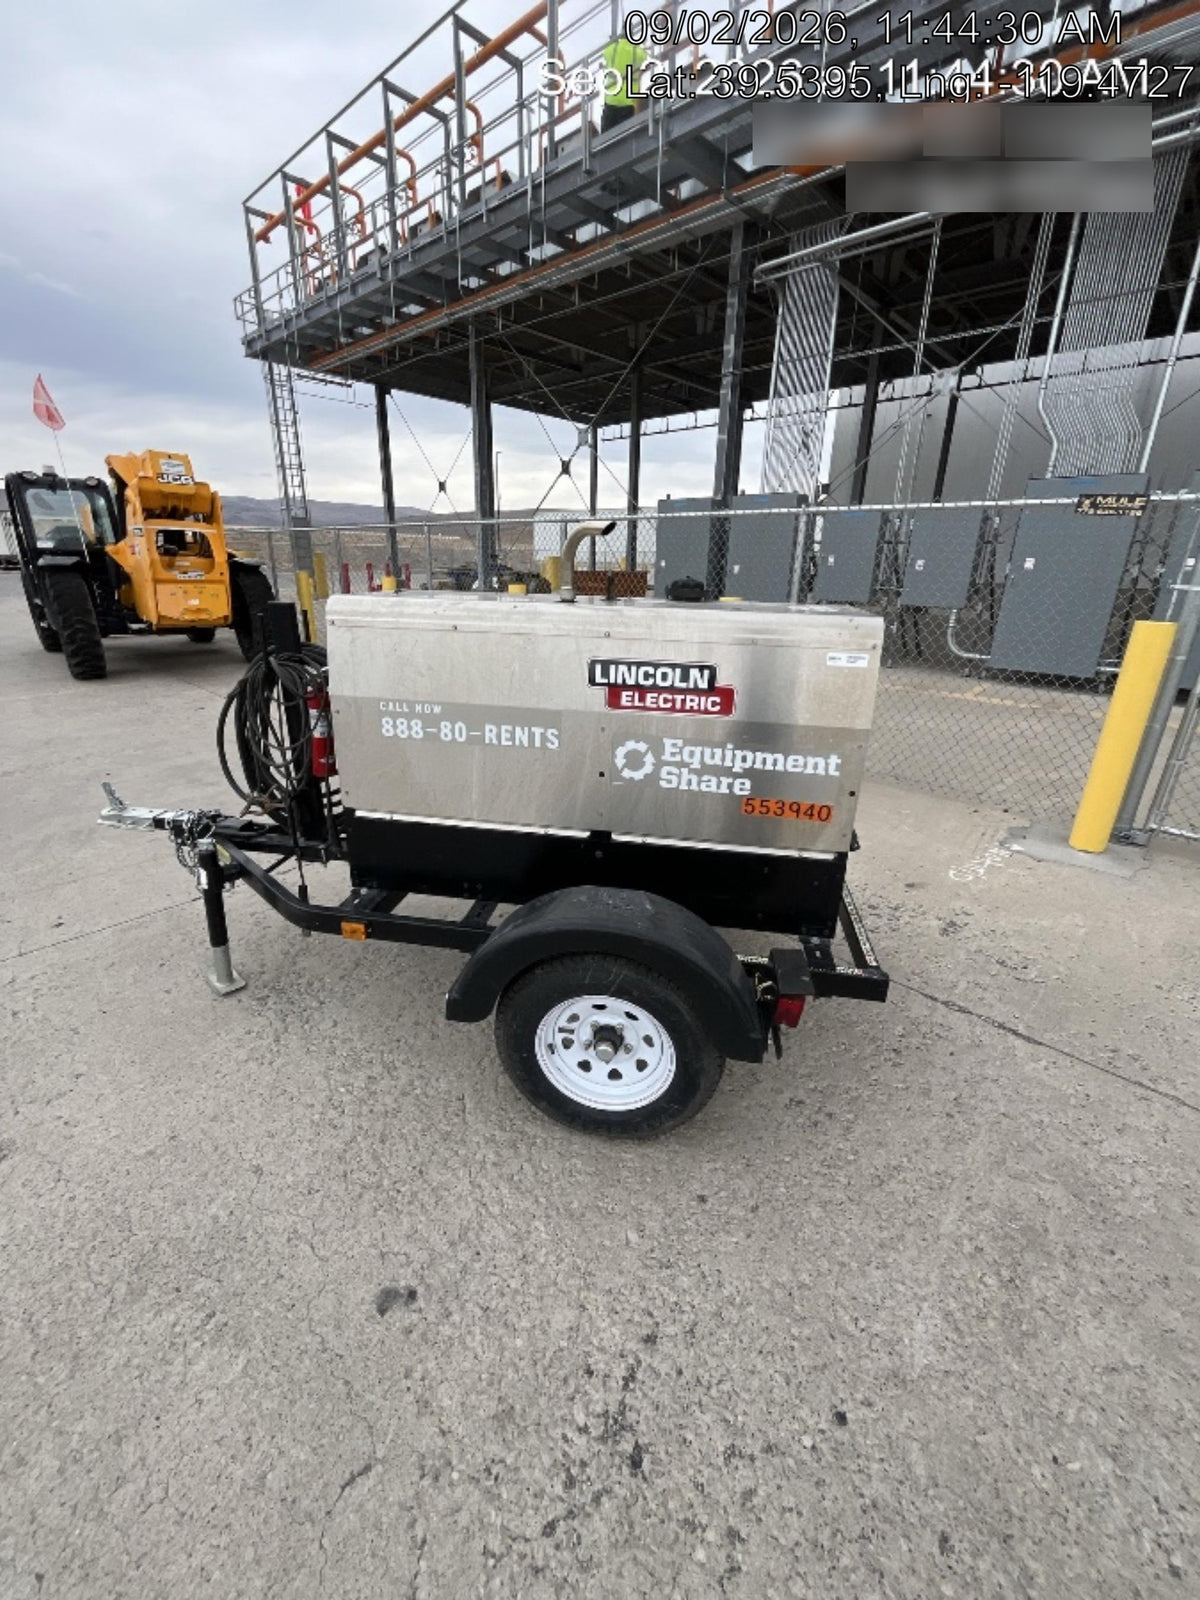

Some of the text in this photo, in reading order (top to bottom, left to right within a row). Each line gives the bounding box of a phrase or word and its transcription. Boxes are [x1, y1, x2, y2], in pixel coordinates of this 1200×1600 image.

[594, 663, 711, 690] LINCOLN
[379, 701, 442, 714] CALL NOW
[619, 691, 722, 712] ELECTRIC
[380, 715, 561, 751] 888-80-RENTS
[660, 737, 842, 777] Equipment
[658, 765, 752, 796] Share
[743, 797, 832, 823] 553940
